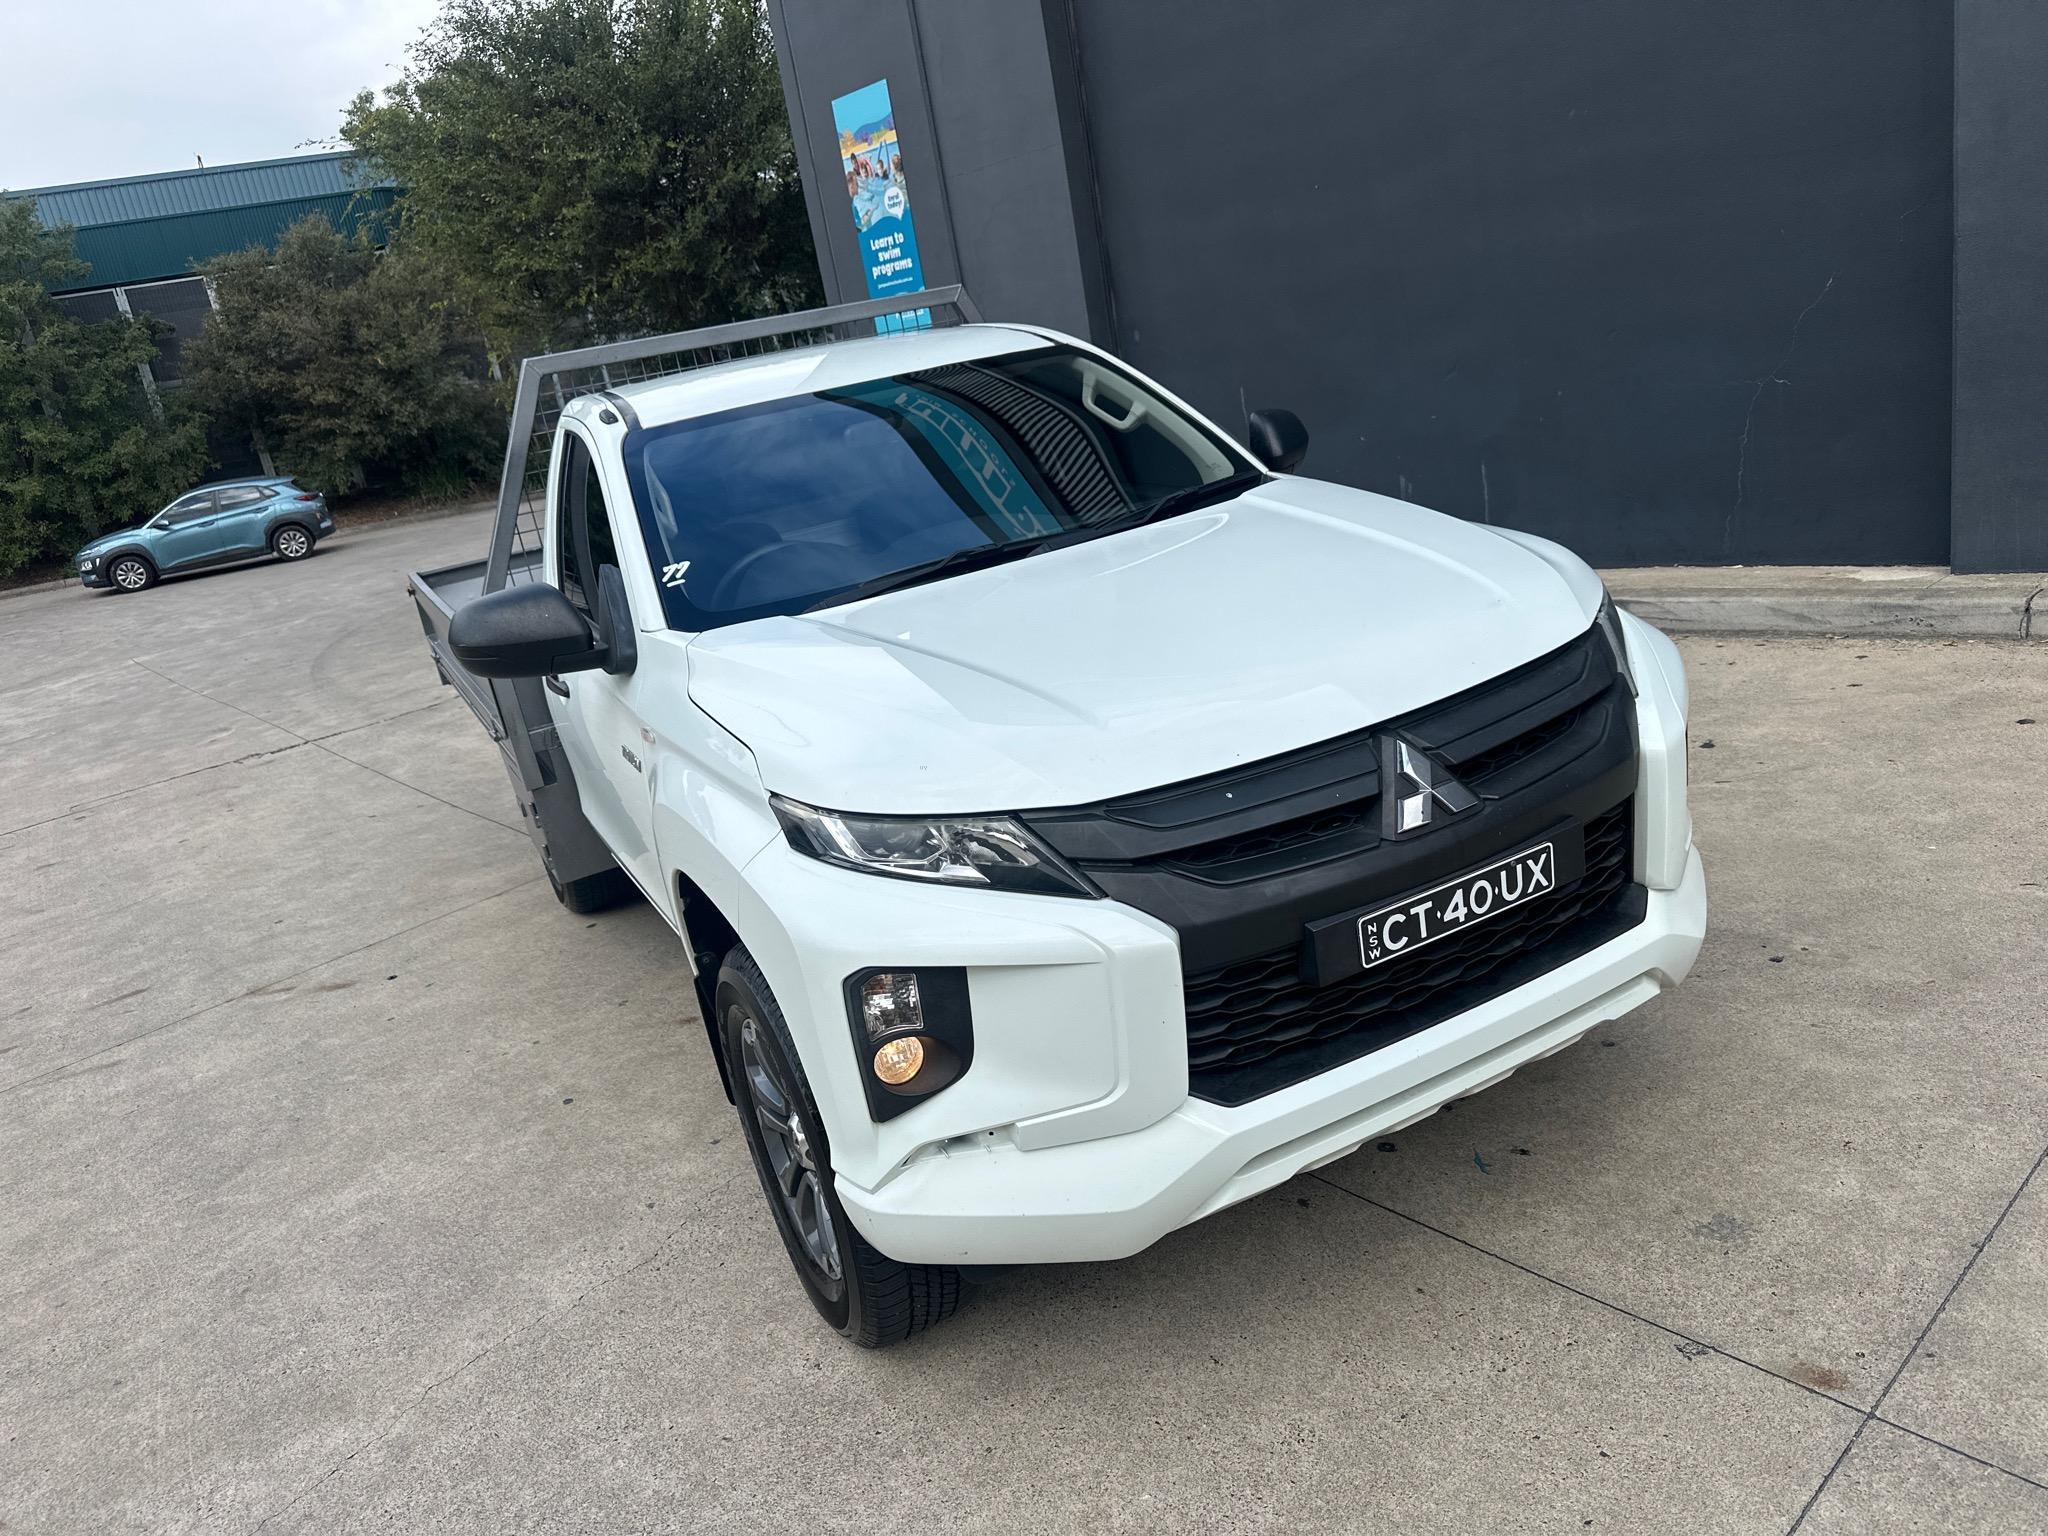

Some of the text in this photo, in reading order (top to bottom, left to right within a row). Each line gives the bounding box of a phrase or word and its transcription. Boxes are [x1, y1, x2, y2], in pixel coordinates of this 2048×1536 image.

[870, 231, 905, 251] Learn to
[878, 246, 902, 262] swim
[872, 257, 913, 280] programs
[1367, 922, 1381, 960] NSW
